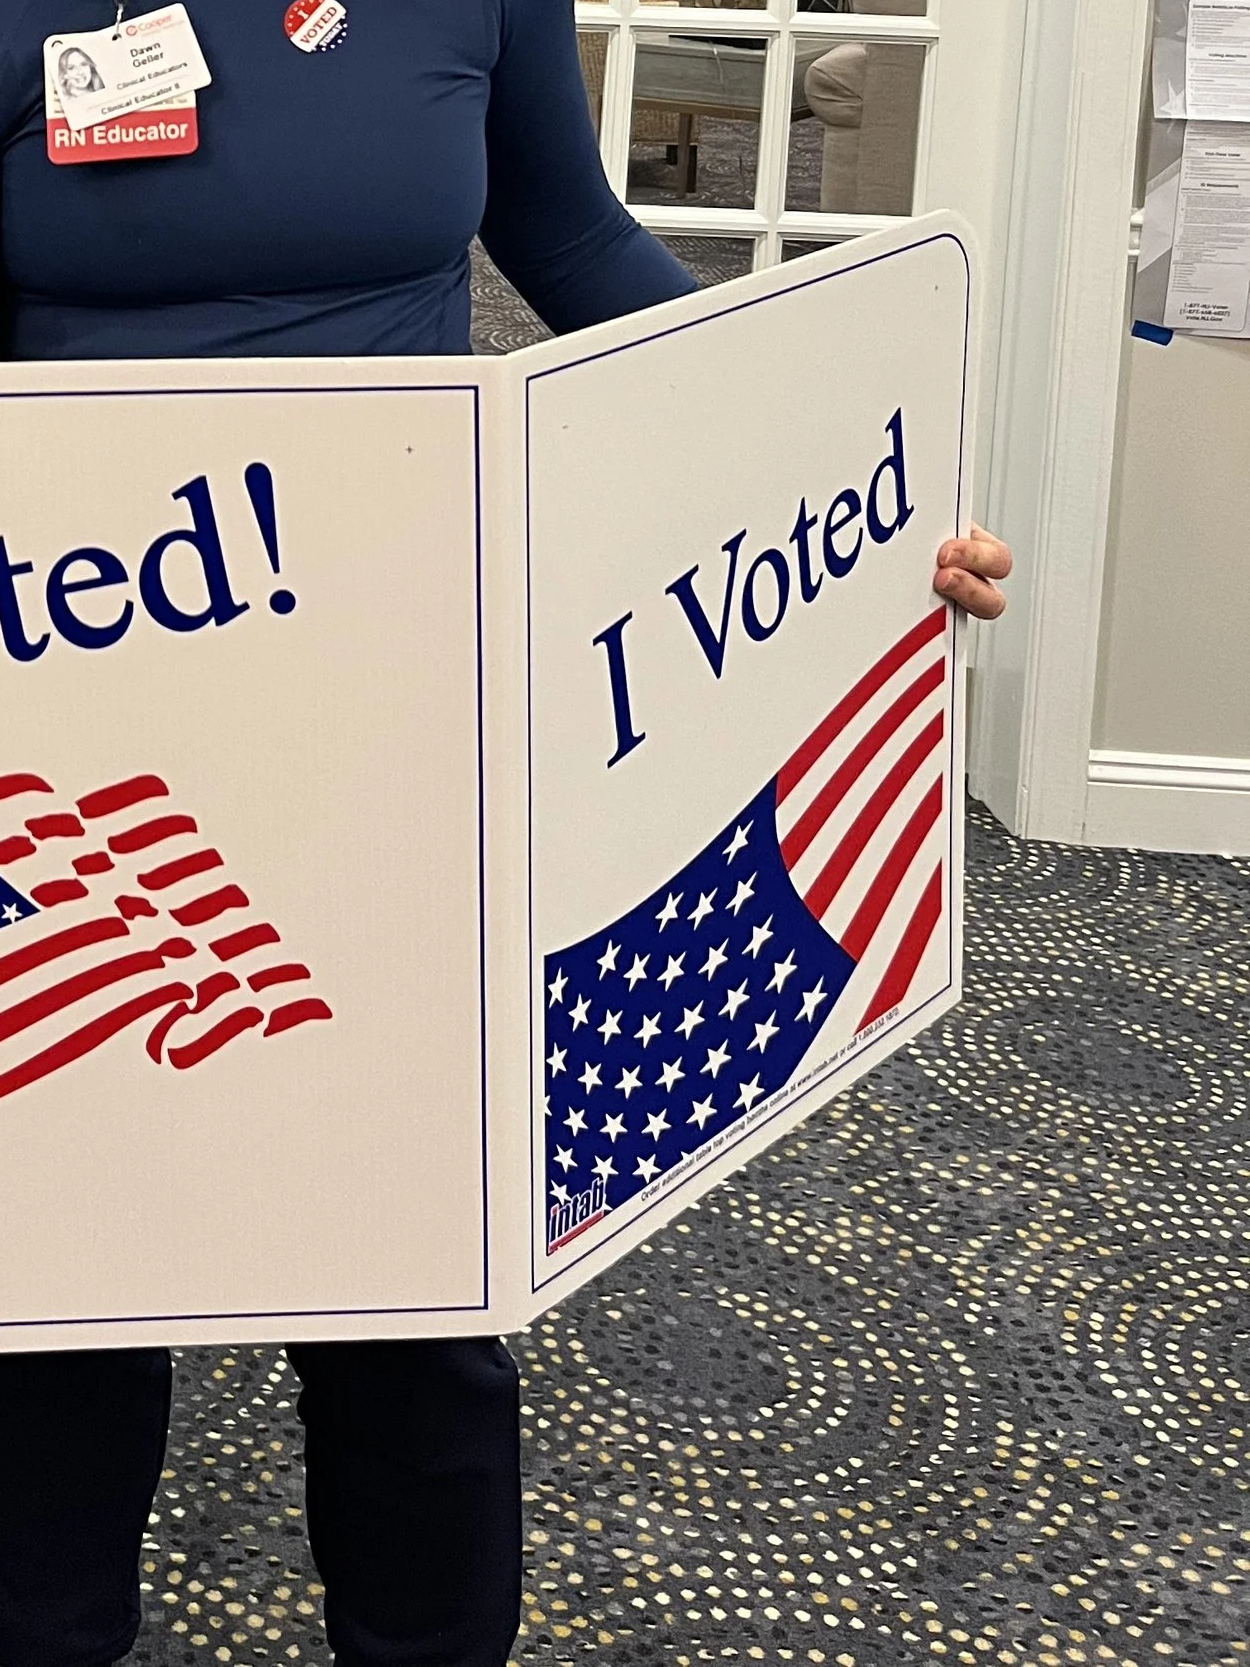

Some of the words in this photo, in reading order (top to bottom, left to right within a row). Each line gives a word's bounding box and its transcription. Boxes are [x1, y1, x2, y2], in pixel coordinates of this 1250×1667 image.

[138, 13, 173, 31] Cooper
[297, 9, 309, 20] I
[300, 6, 337, 43] VOTED
[130, 42, 161, 57] Dawn
[132, 51, 164, 68] Geller
[117, 76, 146, 90] Clinical
[147, 62, 188, 80] Educators
[101, 100, 132, 115] Clinical
[134, 86, 173, 104] Educator
[54, 128, 86, 149] RN
[93, 122, 188, 145] Educator
[592, 610, 646, 769] I
[665, 406, 915, 680] Voted
[641, 1183, 660, 1201] Order
[549, 1177, 605, 1244] intab
